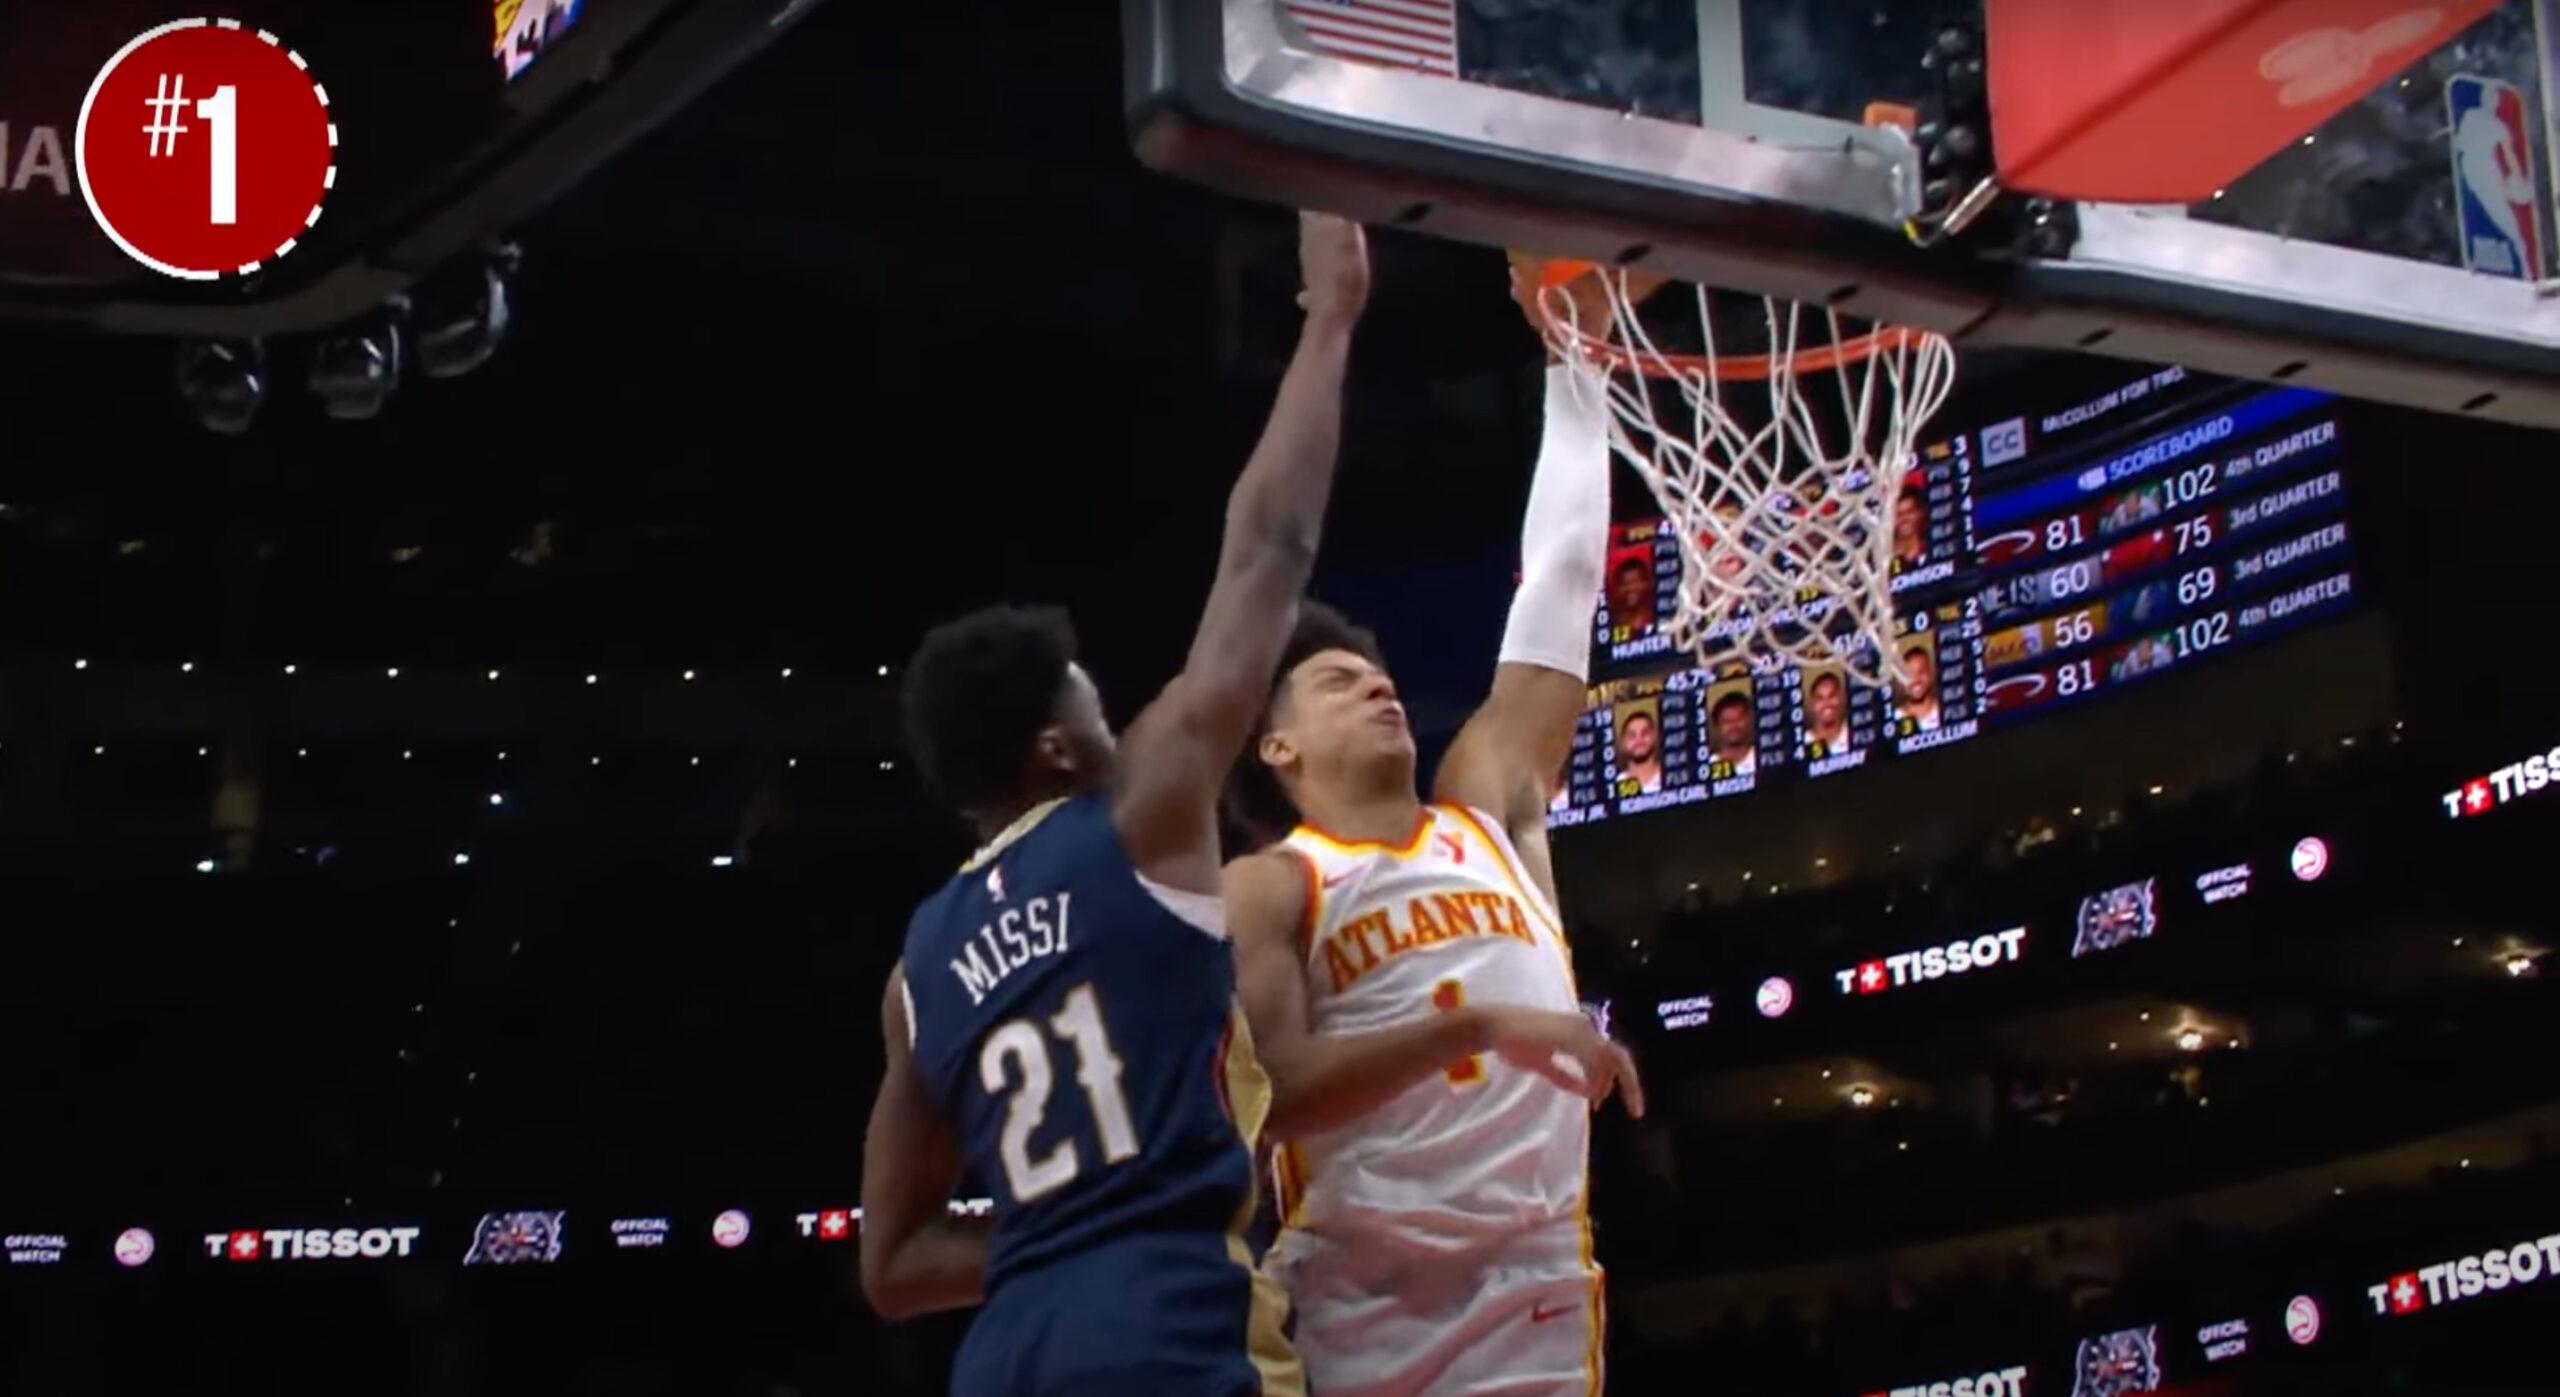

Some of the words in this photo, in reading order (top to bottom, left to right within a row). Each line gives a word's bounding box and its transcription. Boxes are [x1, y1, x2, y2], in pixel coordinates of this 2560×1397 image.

[2121, 378, 2150, 404] FOR
[1954, 435, 1968, 455] 3
[1988, 430, 2020, 454] CC
[2110, 415, 2234, 482] SCOREBOARD
[1959, 476, 1972, 493] 7
[2044, 515, 2084, 549] 81
[2163, 464, 2217, 508] 102
[2225, 452, 2253, 479] 4th
[2254, 421, 2335, 467] QUARTER
[1961, 497, 1973, 511] 4
[2050, 562, 2091, 599] 60
[2174, 517, 2212, 555] 75
[2229, 502, 2258, 529] 3rd
[2260, 472, 2340, 517] QUARTER
[2054, 612, 2094, 648] 56
[2178, 567, 2216, 604] 69
[2234, 553, 2263, 580] 3rd
[2264, 523, 2346, 568] QUARTER
[1914, 611, 1928, 630] 0
[1964, 597, 1978, 618] 2
[1961, 618, 1982, 638] 25
[2057, 660, 2096, 697] 81
[2175, 612, 2232, 657] 102
[2238, 600, 2267, 627] 4th
[2269, 572, 2351, 618] QUARTER
[1612, 635, 1671, 660] HUNTER
[1973, 658, 1984, 675] 1
[1974, 675, 1987, 694] 0
[1696, 689, 1705, 704] 7
[1976, 696, 1987, 714] 2
[1791, 707, 1803, 723] 0
[1697, 727, 1706, 743] 1
[1794, 727, 1803, 742] 1
[1883, 721, 1896, 738] 0
[1603, 746, 1614, 760] 0
[1697, 745, 1708, 761] 0
[1793, 744, 1805, 760] 4
[1604, 764, 1616, 781] 0
[1698, 763, 1710, 780] 0
[1711, 760, 1732, 777] 21
[2442, 790, 2463, 818] T
[2196, 864, 2252, 891] OFFICIAL
[2203, 880, 2248, 904] WATCH
[949, 892, 1071, 1005] MISSI
[1324, 891, 1538, 995] ATLANTA
[1835, 968, 1857, 994] T
[1885, 927, 2026, 985] TISSOT
[1657, 995, 1713, 1018] OFFICIAL
[1664, 1012, 1709, 1031] WATCH
[980, 981, 1142, 1202] 21
[610, 1217, 670, 1233] OFFICIAL
[4, 1234, 69, 1250] OFFICIAL
[205, 1233, 229, 1257] T
[263, 1227, 420, 1259] TISSOT
[617, 1232, 664, 1247] WATCH
[10, 1248, 61, 1263] WATCH
[2368, 1282, 2390, 1314] T
[2417, 1233, 2560, 1305] TISSOT
[2197, 1319, 2249, 1344] OFFICIAL
[2205, 1340, 2247, 1362] WATCH
